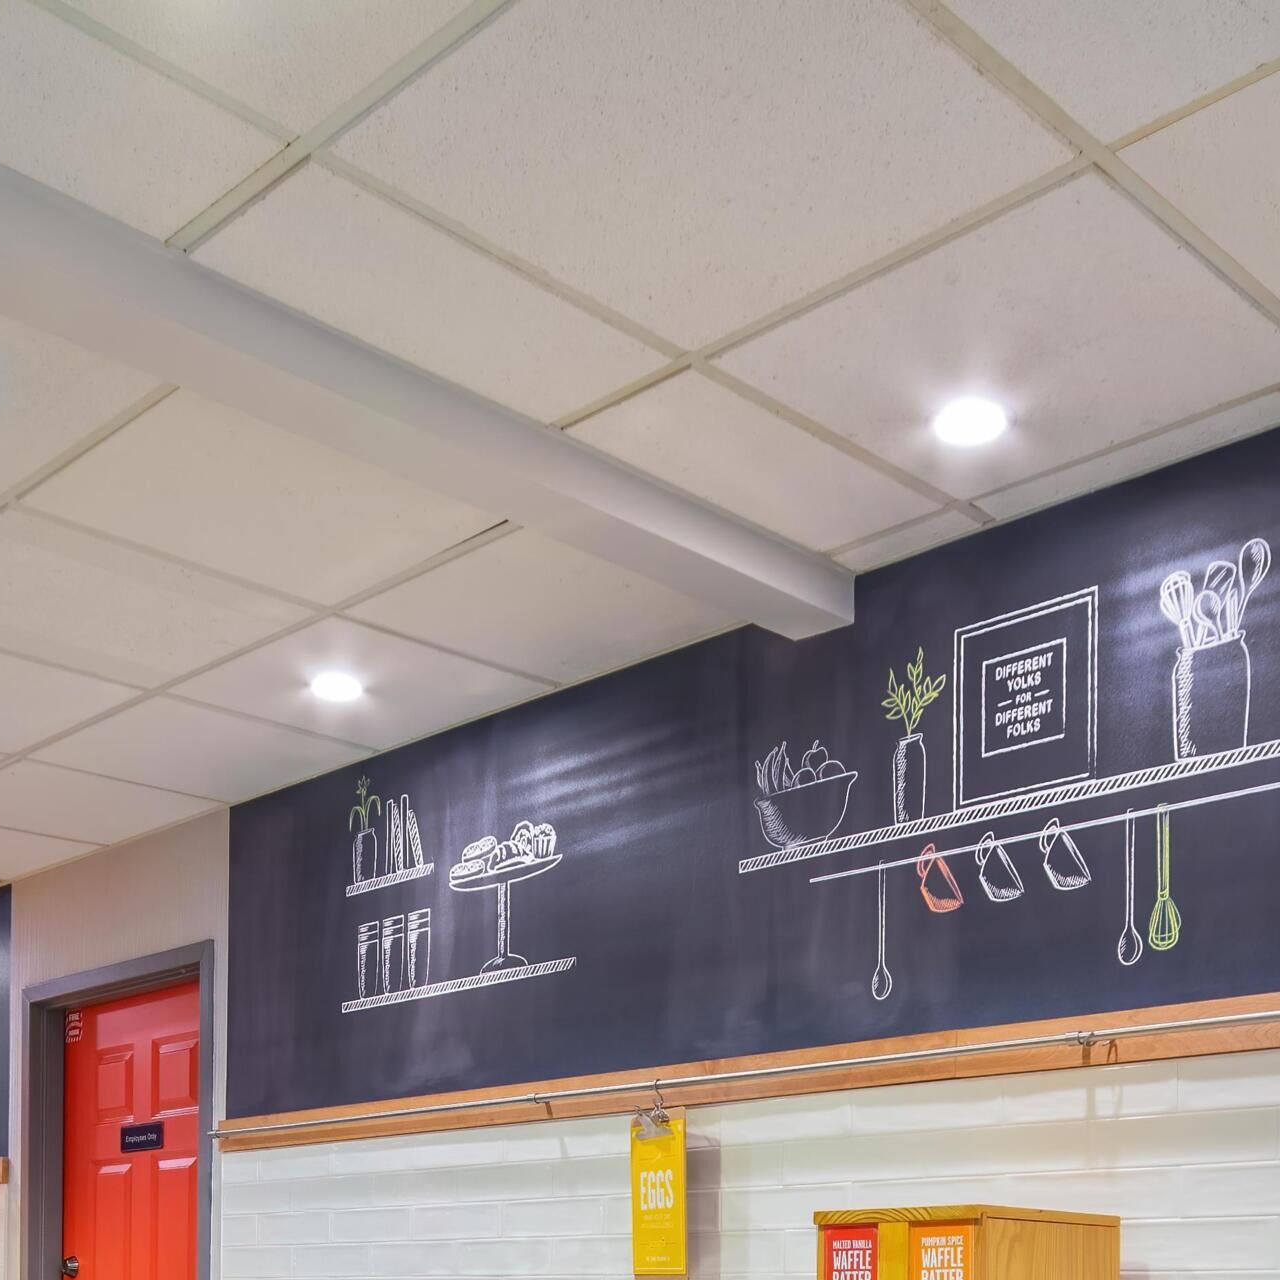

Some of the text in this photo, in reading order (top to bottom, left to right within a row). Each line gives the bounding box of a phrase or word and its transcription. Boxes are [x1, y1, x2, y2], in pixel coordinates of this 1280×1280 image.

[995, 652, 1053, 680] DIFFERENT
[1007, 671, 1041, 692] YOLKS
[1015, 692, 1032, 704] FOR
[995, 699, 1053, 726] DIFFERENT
[1007, 718, 1040, 739] FOLKS
[640, 1169, 674, 1210] EGGS
[832, 1250, 872, 1270] WAFFLE
[921, 1247, 964, 1268] WAFFLE
